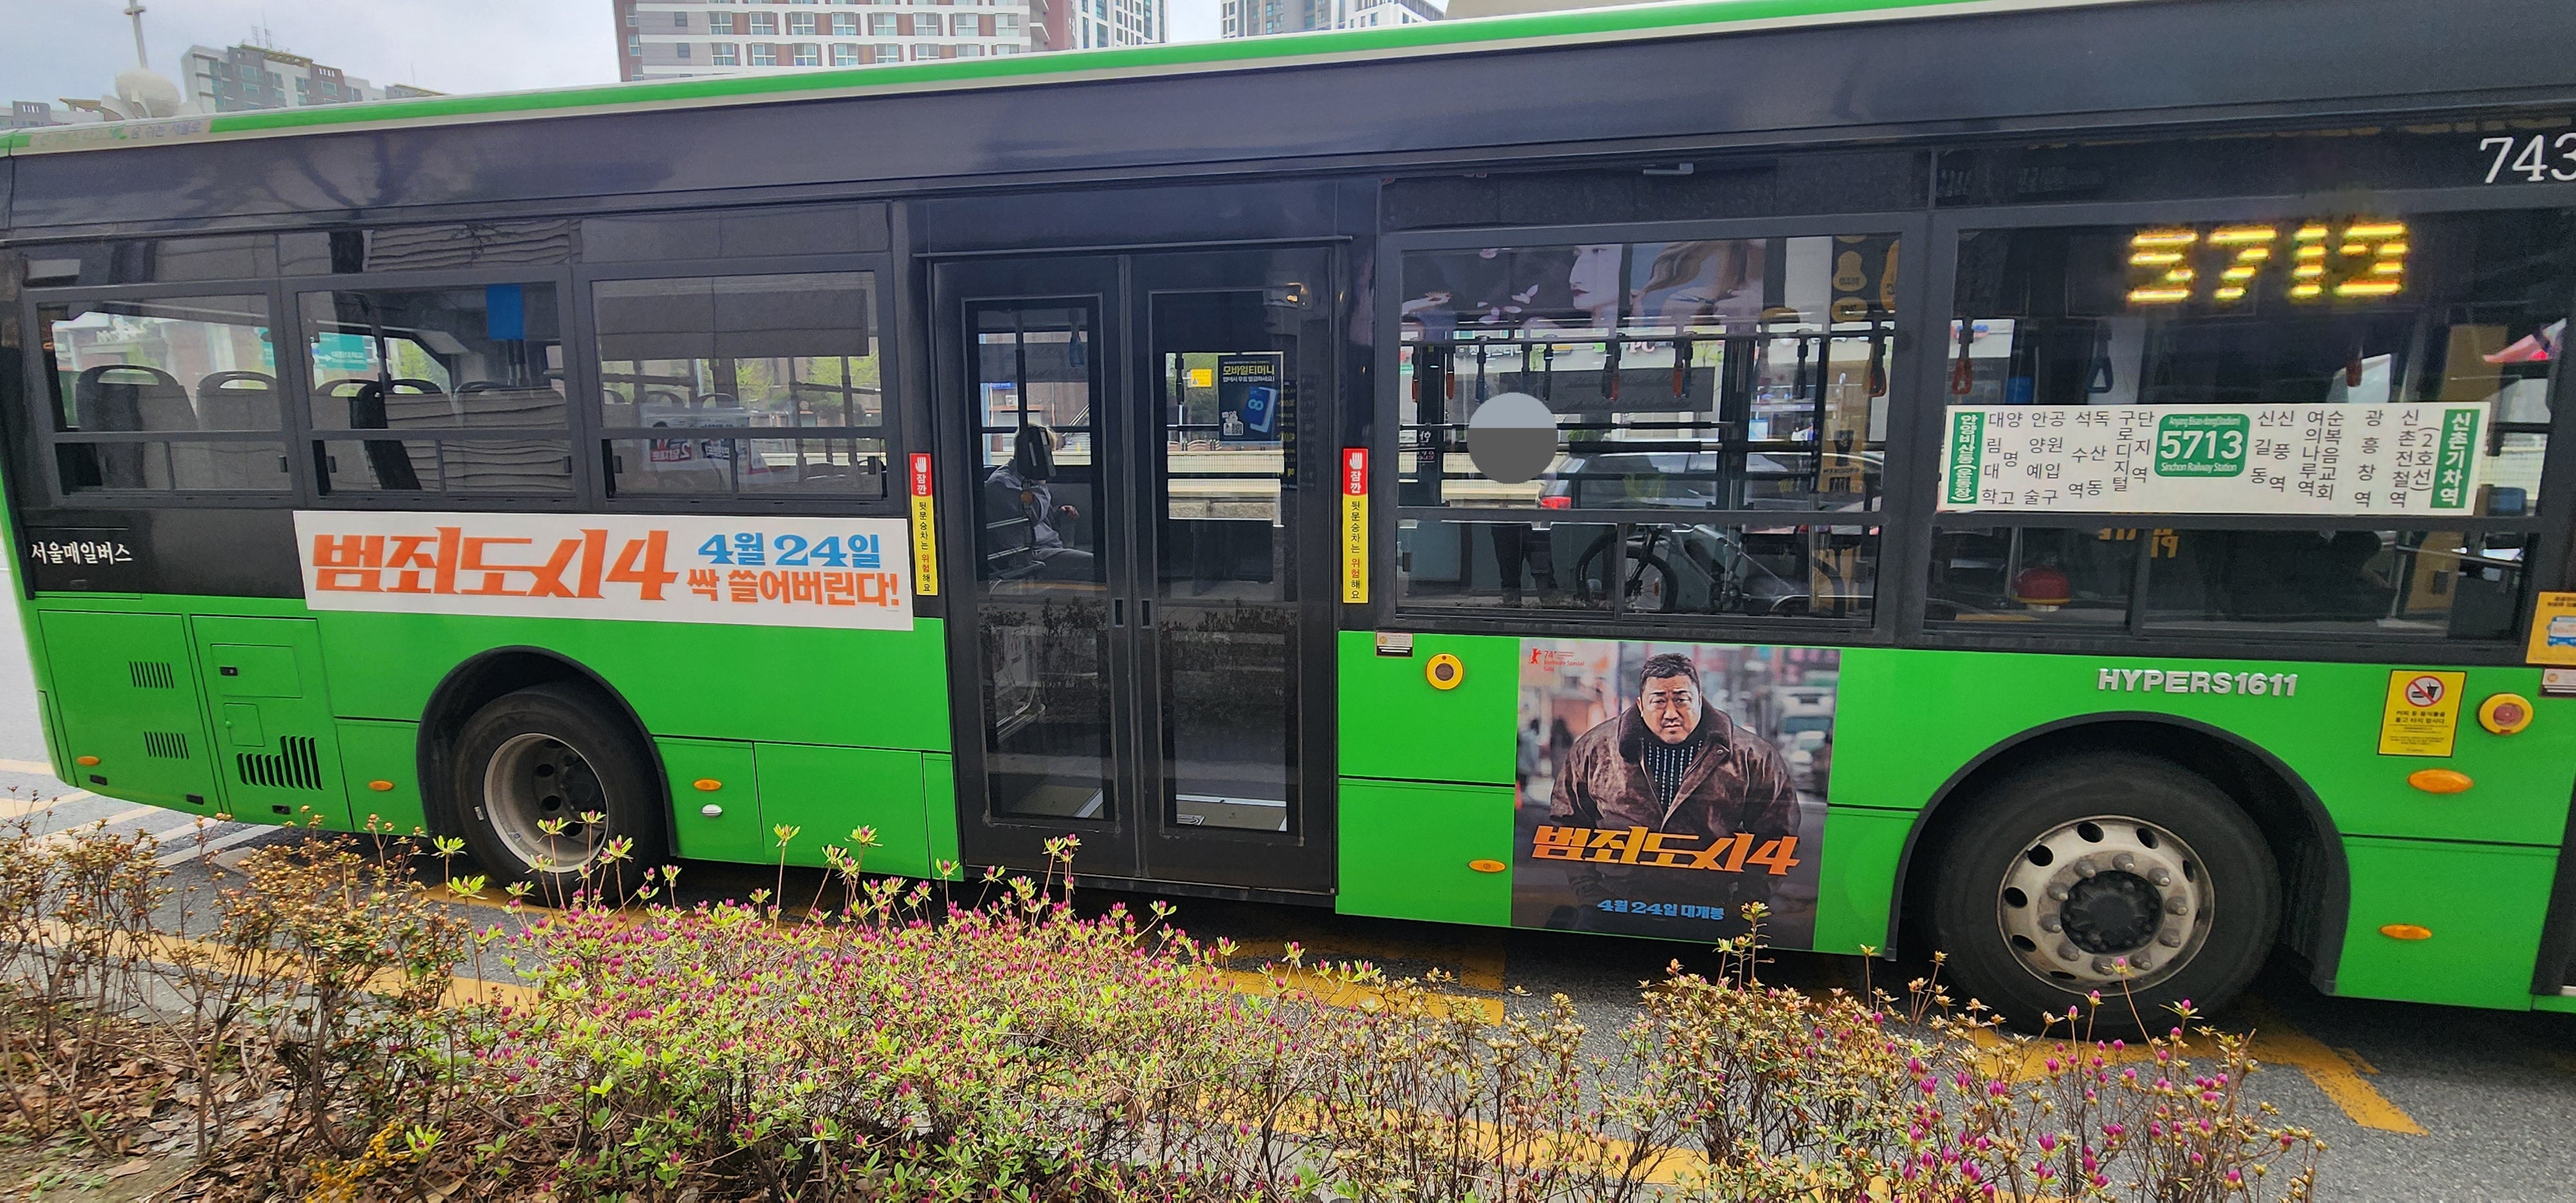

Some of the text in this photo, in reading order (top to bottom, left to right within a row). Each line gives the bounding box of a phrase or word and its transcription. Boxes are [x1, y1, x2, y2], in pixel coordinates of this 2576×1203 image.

[1223, 365, 1275, 375] 모바일티머니
[1350, 471, 1361, 493] 잠깐
[1998, 412, 2023, 505] 양명고
[2069, 411, 2091, 498] 석수역
[2087, 411, 2110, 496] 독산동
[2113, 411, 2136, 491] 구로디지털
[2161, 430, 2243, 459] 5713
[2161, 462, 2237, 473] Sinchon Railway Station
[2250, 410, 2275, 484] 신길동
[2269, 410, 2294, 492] 신풍역
[2298, 410, 2324, 497] 여의나루역
[2316, 410, 2344, 500] 순복음교회
[2354, 410, 2383, 507] 광흥창역
[2390, 410, 2419, 507] 신촌전철역
[2440, 412, 2472, 506] 신촌기차역
[916, 474, 927, 495] 잠깐
[31, 541, 133, 565] 서울매일버스
[312, 526, 679, 601] 범죄도시4
[698, 533, 881, 569] 4월 24일
[919, 502, 931, 591] 뒷문승차는 위험해요
[1350, 501, 1360, 599] 뒷문승차는 위험해요
[687, 569, 900, 607] 싹 쓸어버린다!
[2098, 668, 2298, 696] HYPERS1611
[1531, 825, 1801, 875] 범죄도시4
[1597, 900, 1725, 920] 4월 24일 대개봉
